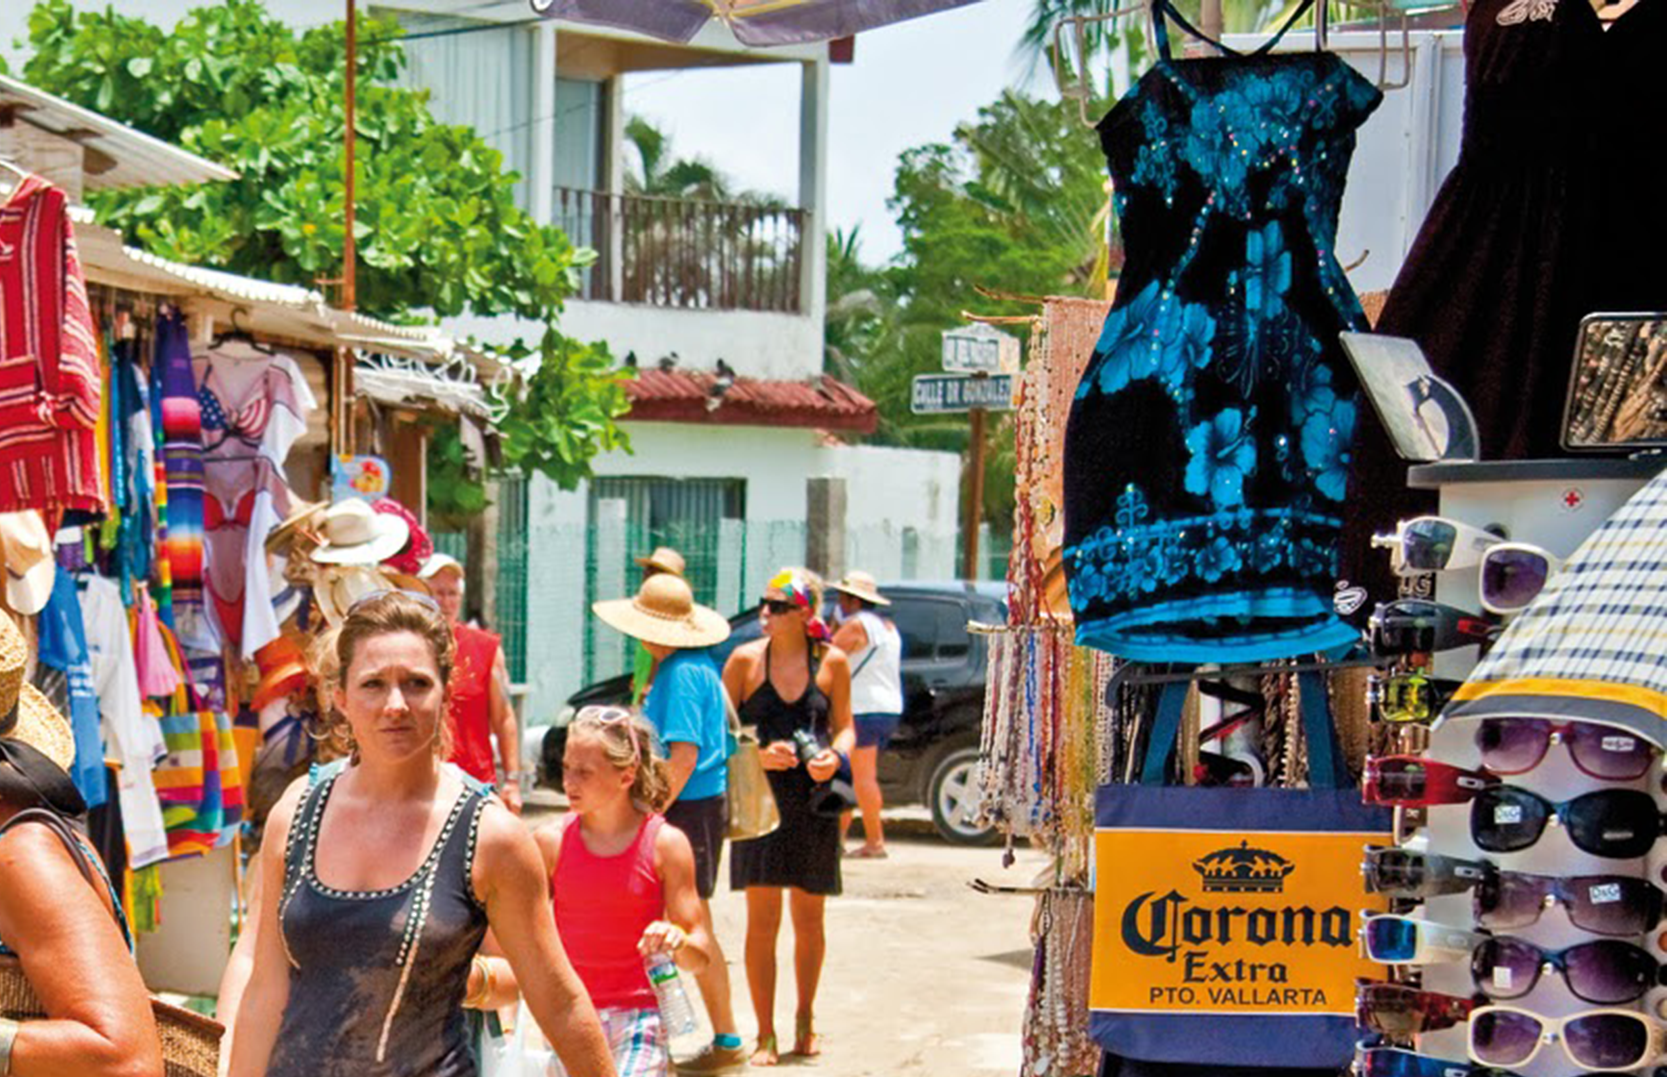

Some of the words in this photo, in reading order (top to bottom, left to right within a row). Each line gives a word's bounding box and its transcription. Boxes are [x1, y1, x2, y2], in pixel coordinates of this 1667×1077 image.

[1121, 889, 1353, 963] Corona
[1183, 951, 1288, 983] Extra
[1149, 986, 1200, 1005] PTO.
[1207, 988, 1327, 1006] VALLARTA
